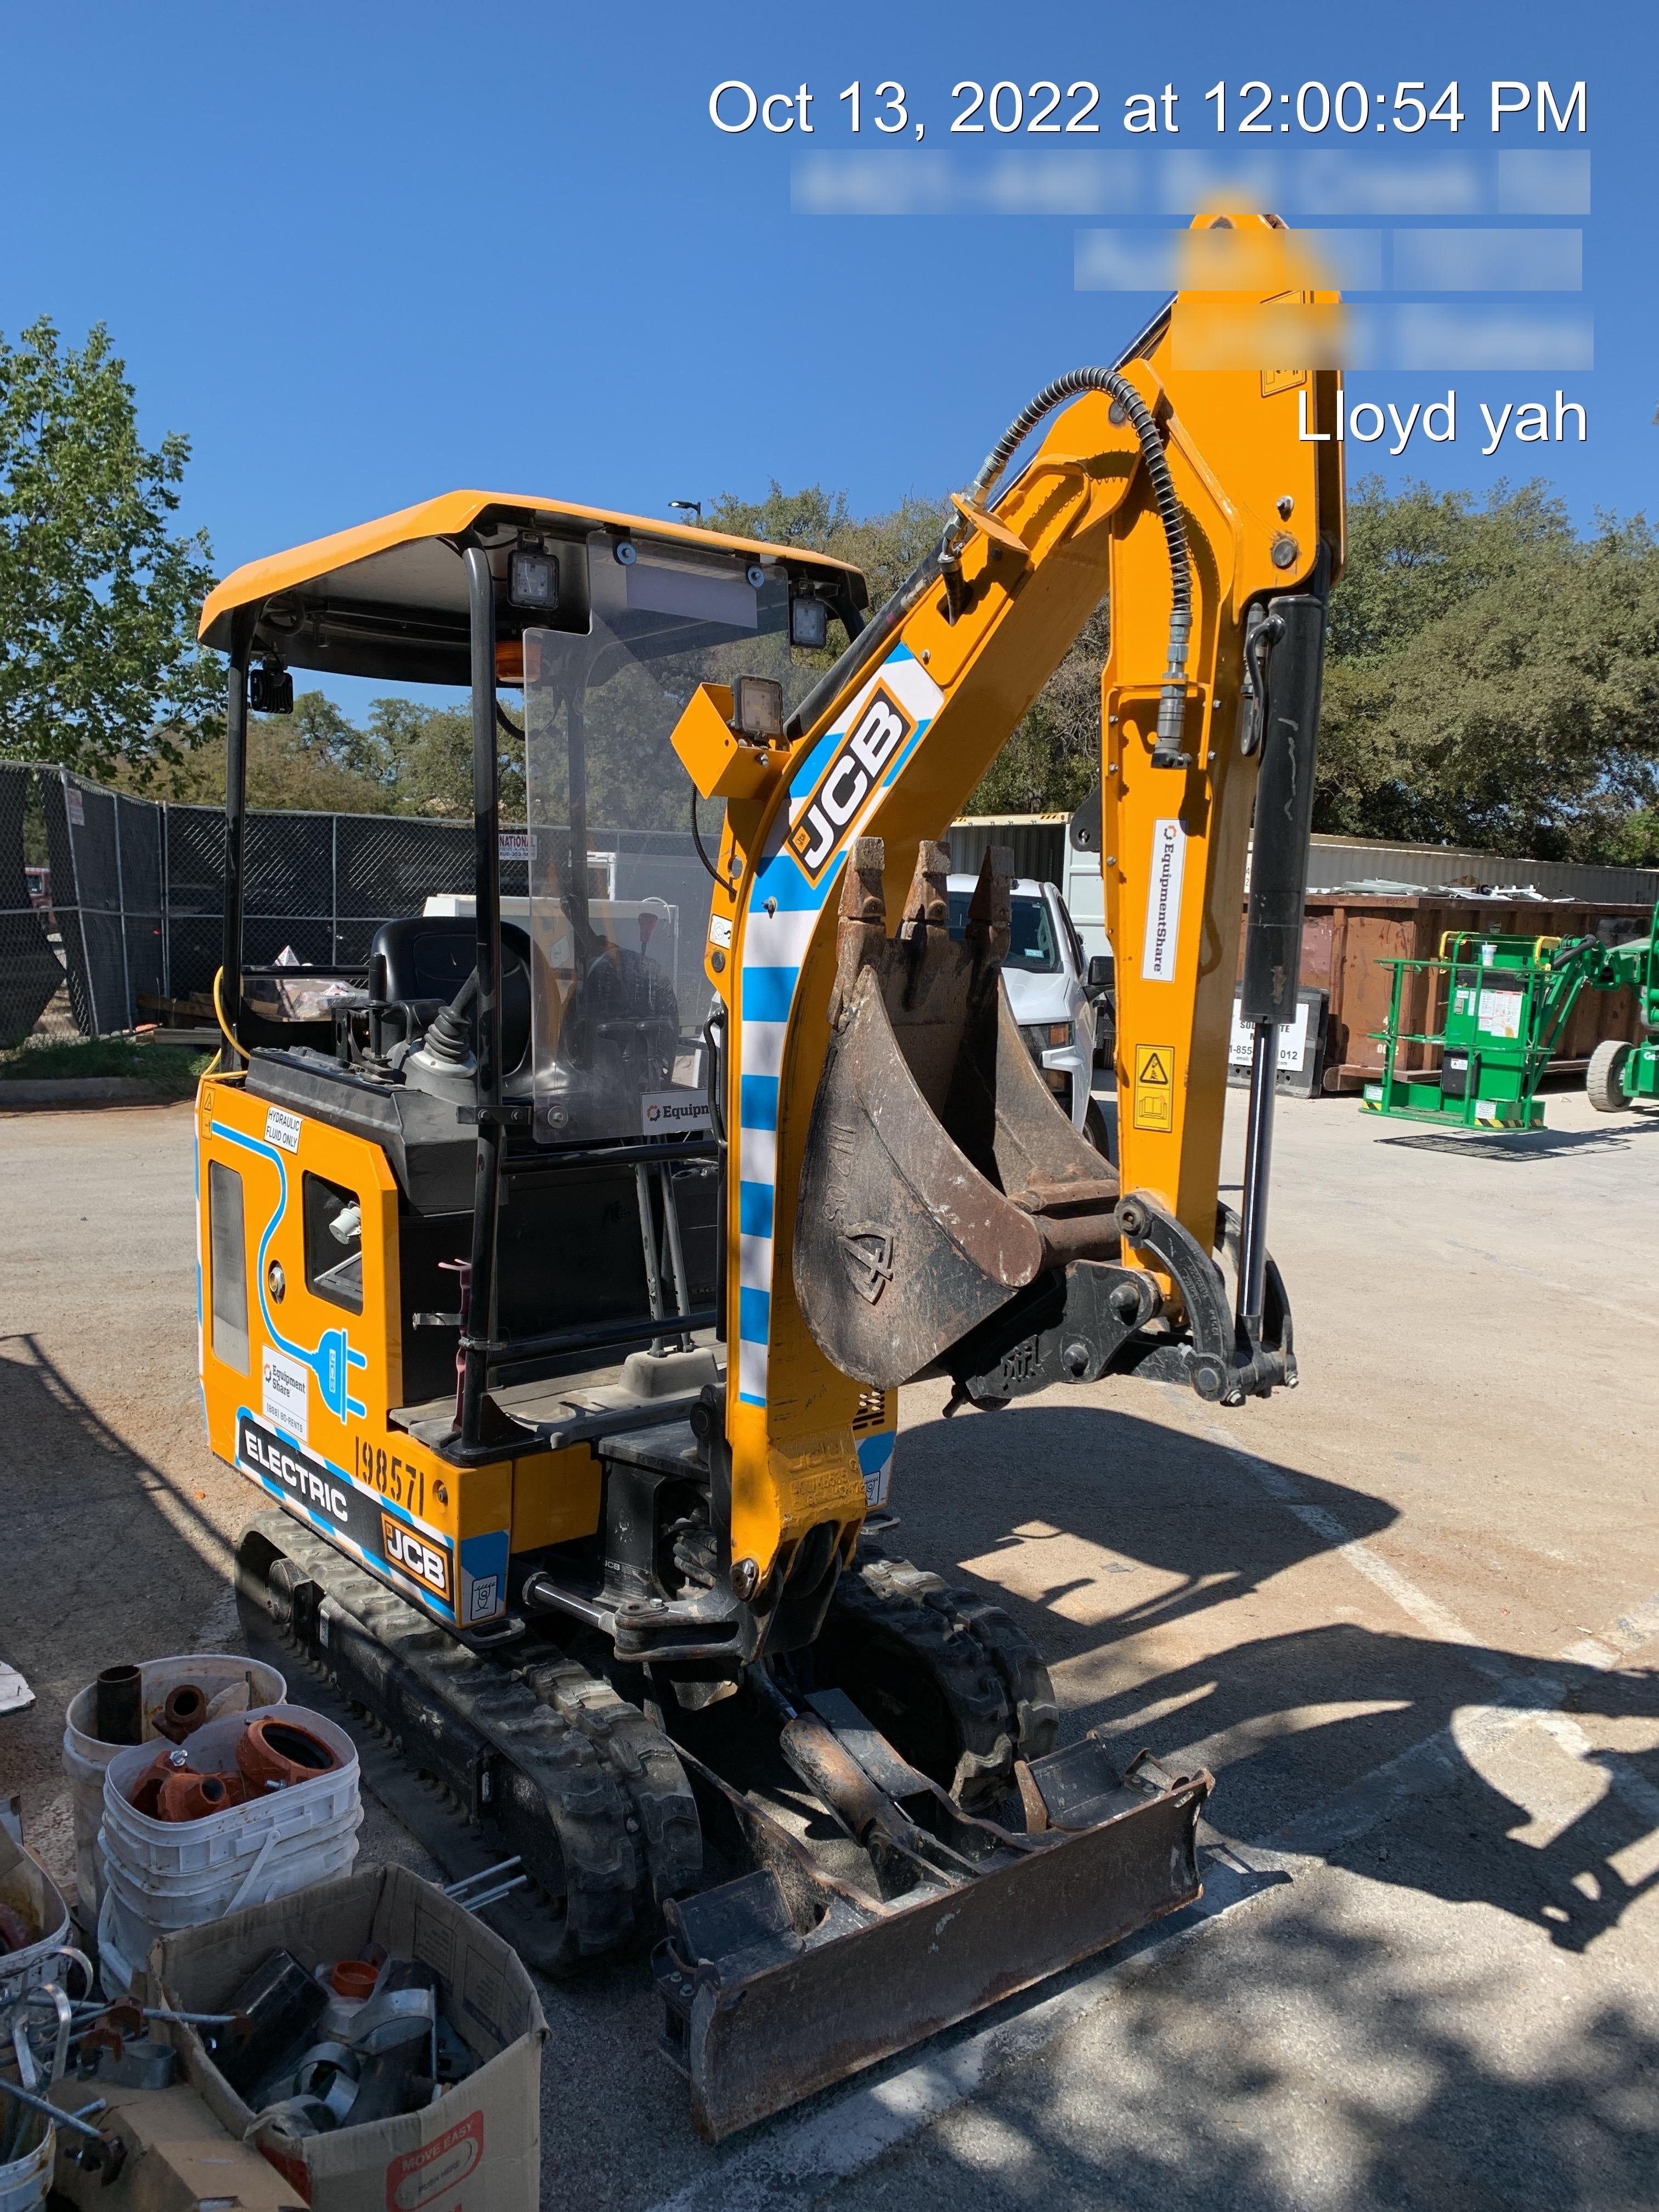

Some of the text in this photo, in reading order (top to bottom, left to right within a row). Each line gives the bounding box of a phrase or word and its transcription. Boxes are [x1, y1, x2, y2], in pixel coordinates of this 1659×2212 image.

[804, 701, 903, 869] JCB
[1153, 843, 1174, 972] EquipmentShare
[266, 1125, 298, 1148] FLUID ONLY
[268, 1109, 300, 1132] HYDRAULIC
[272, 1364, 306, 1394] Equipment
[272, 1376, 291, 1398] Share
[266, 1402, 303, 1434] (888) 80-RENTS
[245, 1429, 348, 1523] ELECTRIC
[356, 1435, 425, 1517] 198571
[387, 1528, 445, 1589] JCB
[402, 2120, 473, 2173] MOVE EASY
